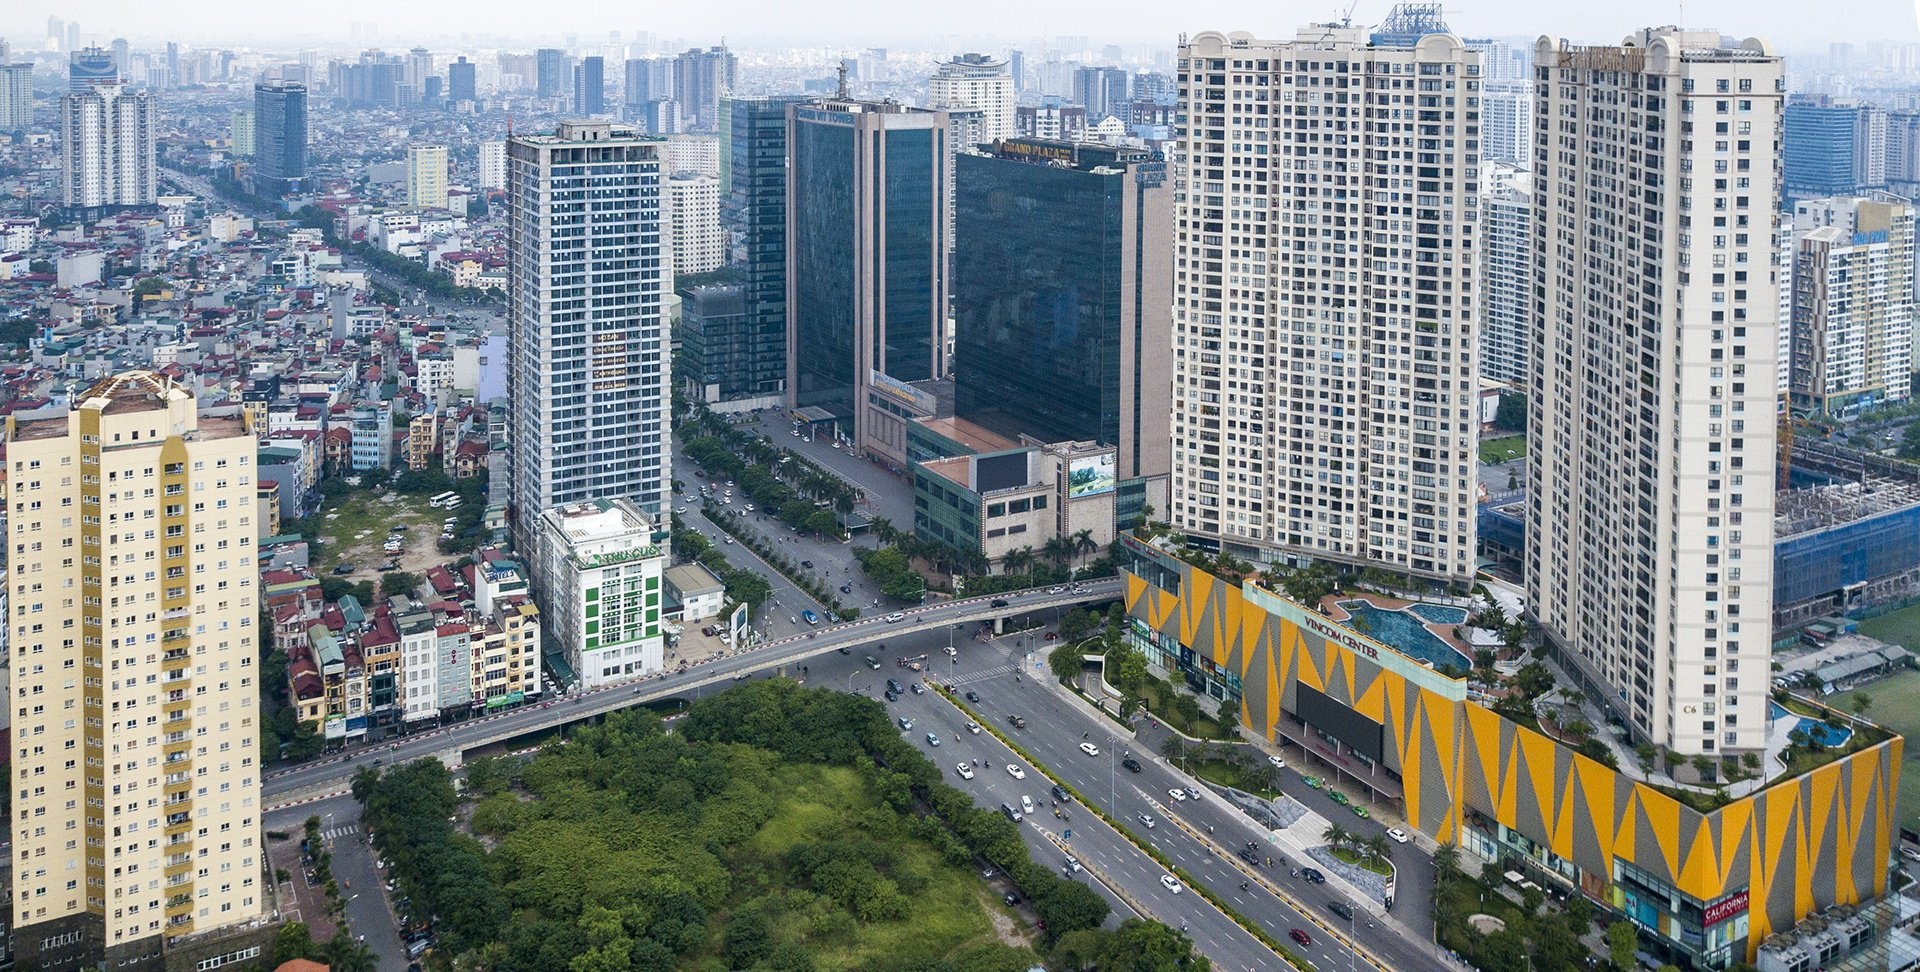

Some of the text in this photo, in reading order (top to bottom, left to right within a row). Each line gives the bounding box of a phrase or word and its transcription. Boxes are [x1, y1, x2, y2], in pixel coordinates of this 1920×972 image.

[1004, 142, 1031, 155] GRAND
[1032, 145, 1060, 158] PLAZA
[1136, 163, 1167, 172] GRAND
[1304, 616, 1384, 661] VINCOM CENTER
[1683, 705, 1697, 714] C6
[1705, 894, 1748, 920] CALIFORNIA
